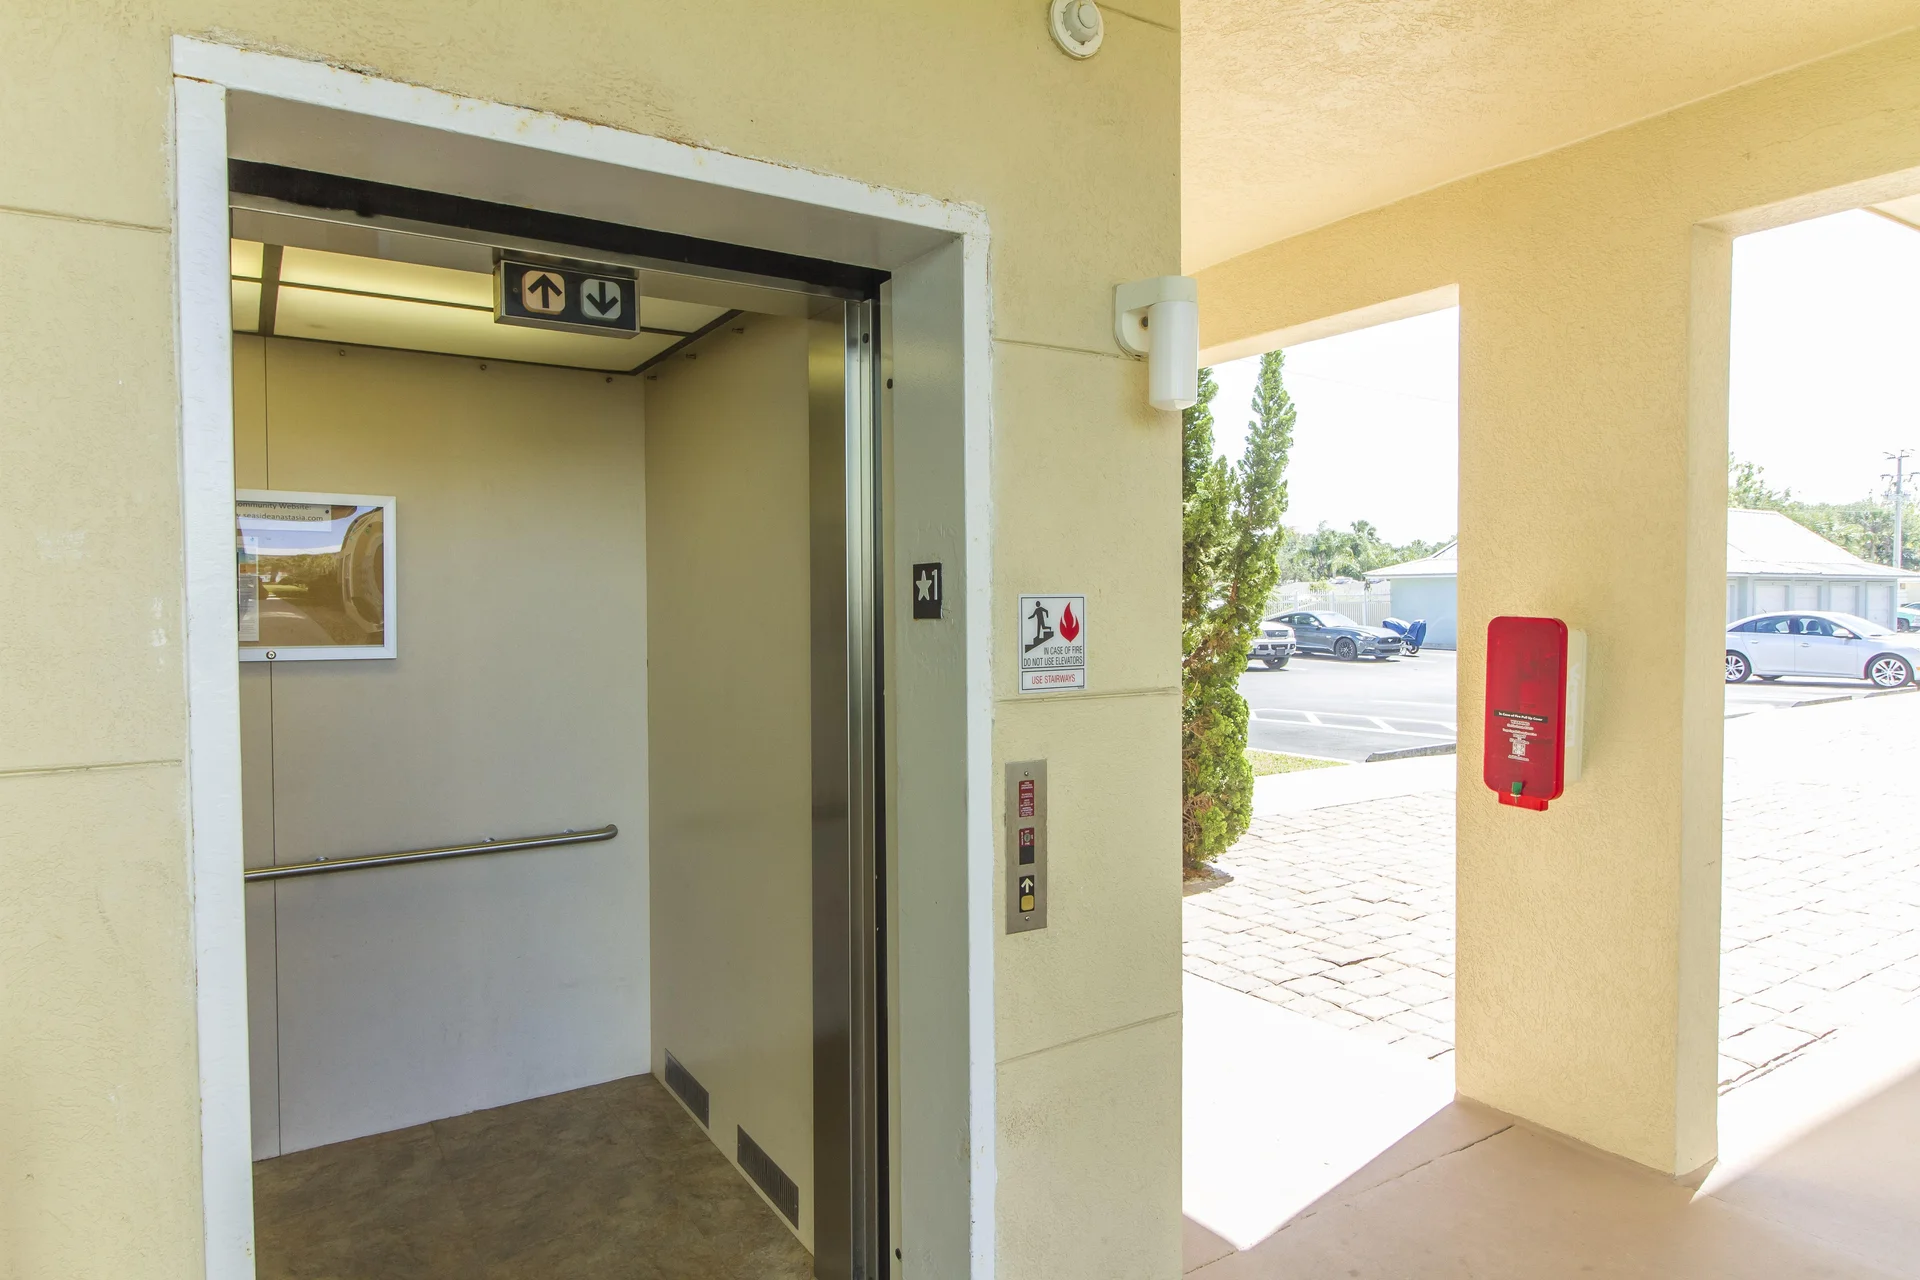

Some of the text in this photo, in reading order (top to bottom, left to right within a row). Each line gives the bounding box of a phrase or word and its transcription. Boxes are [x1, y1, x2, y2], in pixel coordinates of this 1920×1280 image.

[236, 502, 312, 510] ommunity Website:
[1044, 646, 1082, 655] IN CASE OF FIRE
[1024, 656, 1082, 666] DO NOT USE ELEVATORS
[1032, 674, 1075, 685] USE STAIRWAYS
